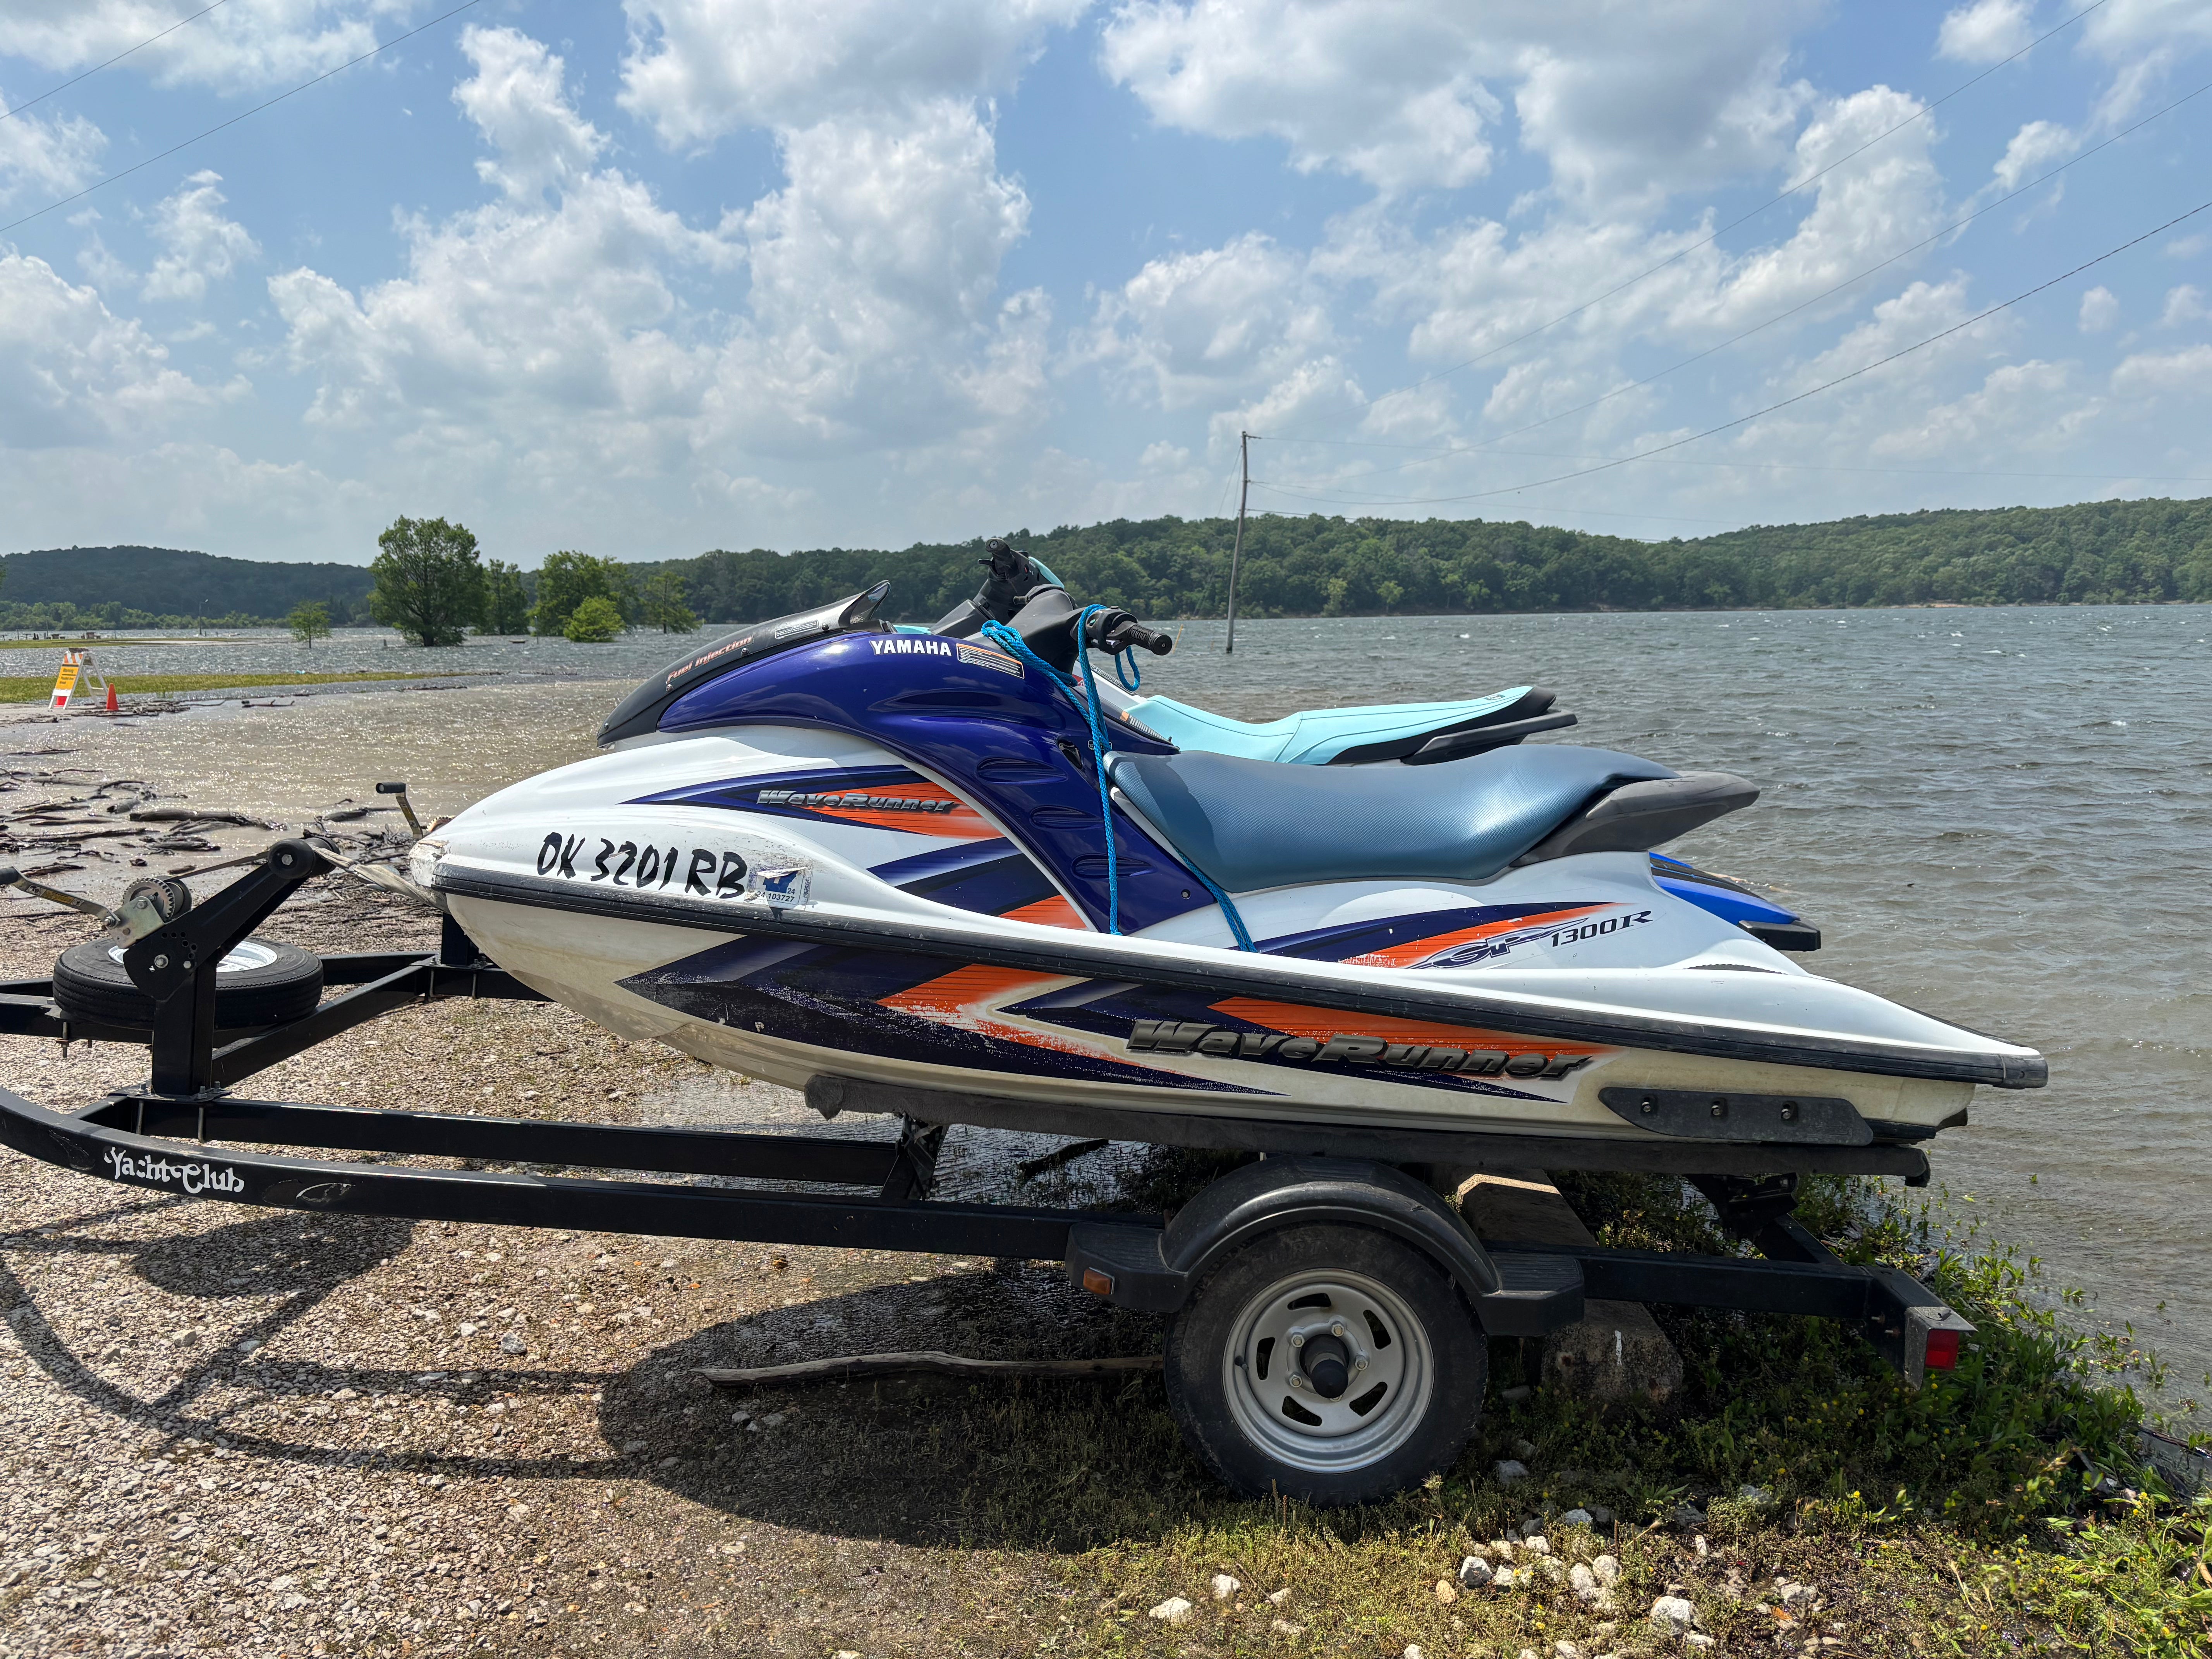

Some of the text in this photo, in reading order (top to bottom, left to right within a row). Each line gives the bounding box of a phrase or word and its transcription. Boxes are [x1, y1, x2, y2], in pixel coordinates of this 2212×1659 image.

[871, 640, 952, 656] YAMAHA
[667, 661, 693, 682] Fuel
[757, 790, 956, 811] WaveRunner
[538, 832, 585, 879] OK
[591, 838, 678, 891] 3201
[684, 848, 748, 899] RB
[768, 893, 795, 902] 103727
[1552, 910, 1654, 948] 1300R
[1125, 1018, 1594, 1078] WaveRunner
